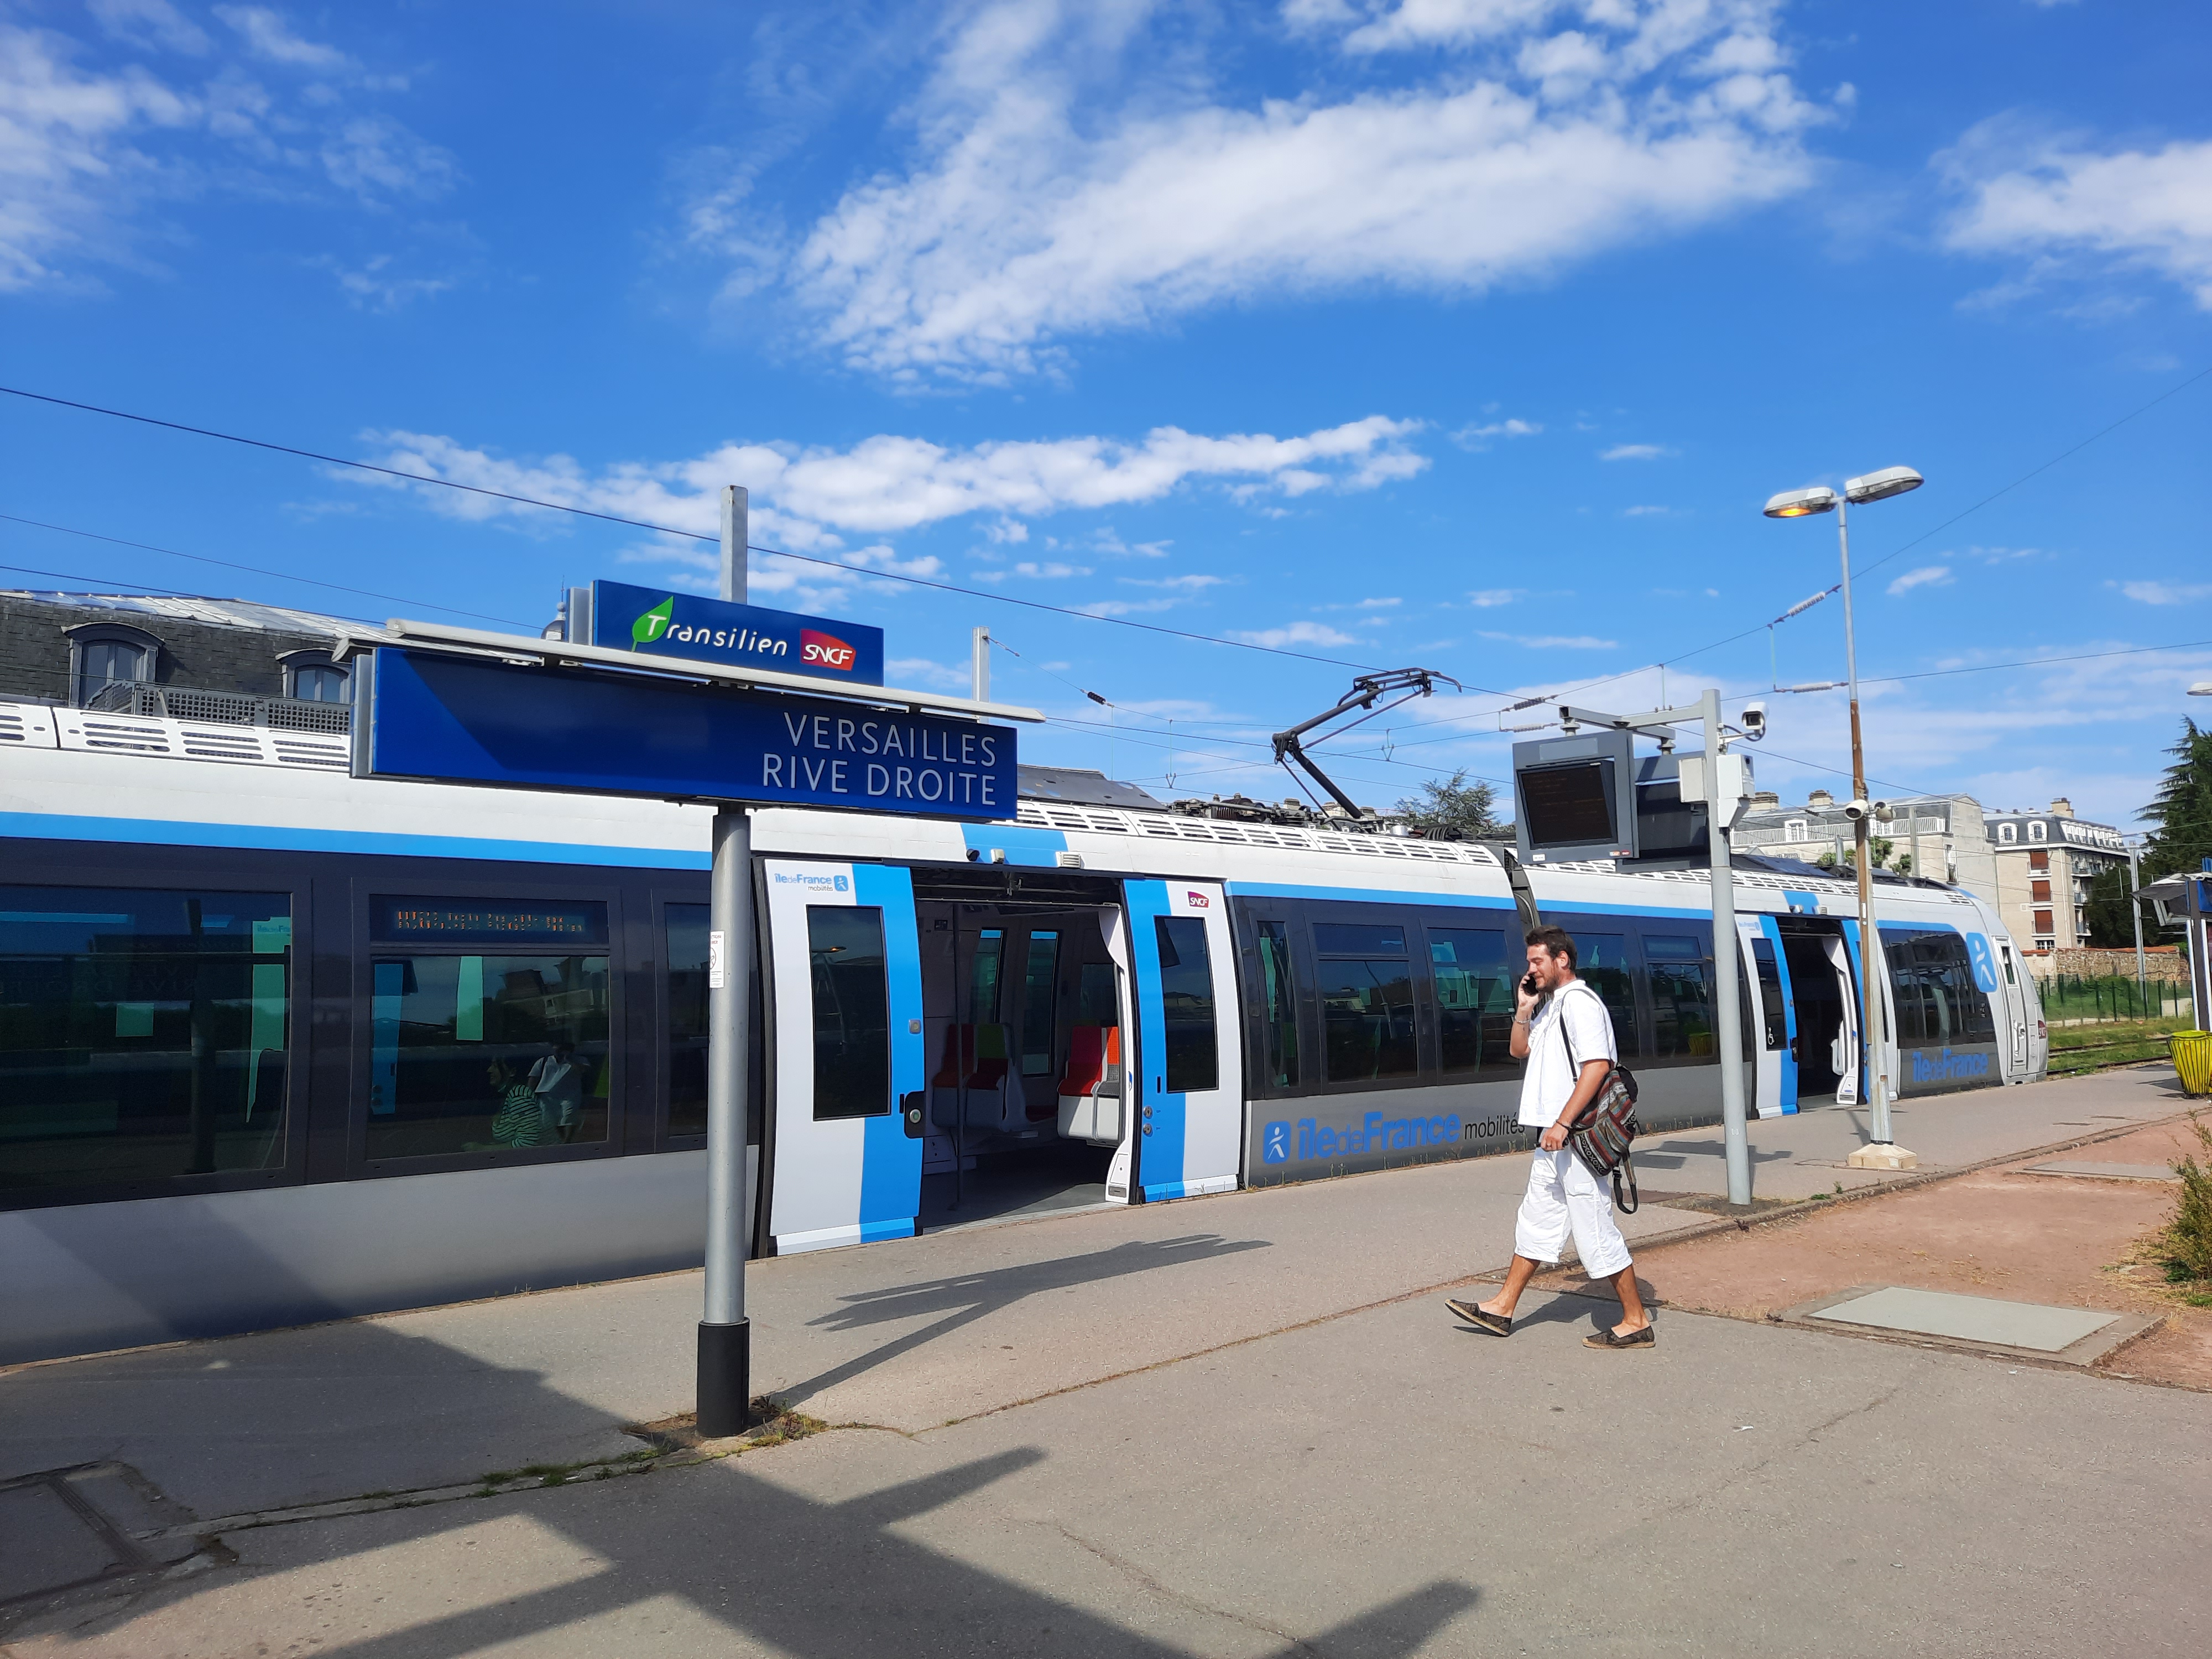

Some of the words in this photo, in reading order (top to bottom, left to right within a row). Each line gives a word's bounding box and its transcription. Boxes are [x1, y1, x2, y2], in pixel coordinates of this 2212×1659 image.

[646, 615, 787, 656] Transilien
[803, 644, 853, 665] SNCF
[784, 712, 996, 768] VERSAILLES
[763, 753, 848, 794] RIVE
[867, 763, 997, 806] DROITE
[1190, 897, 1208, 906] SNCF
